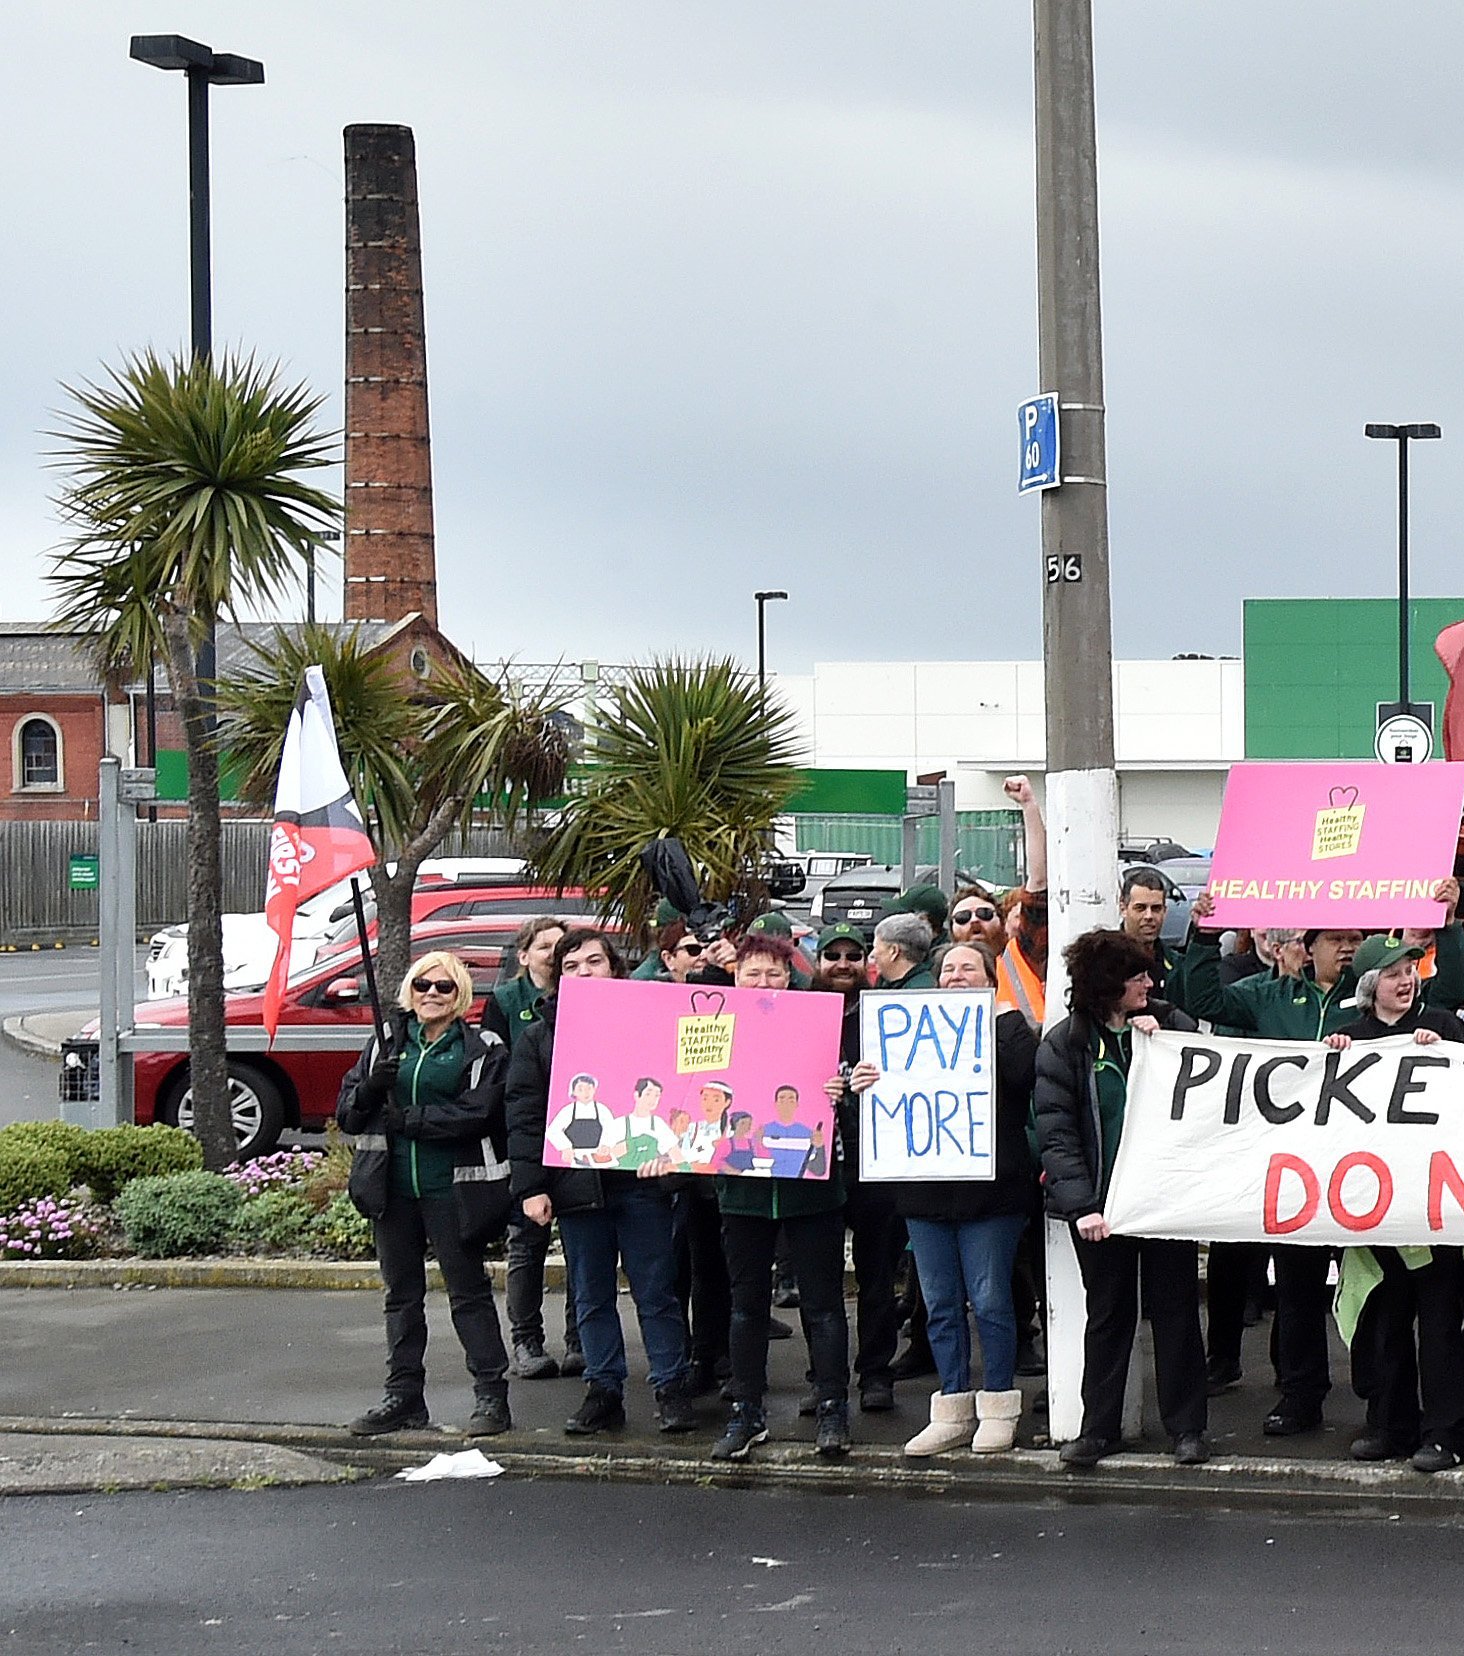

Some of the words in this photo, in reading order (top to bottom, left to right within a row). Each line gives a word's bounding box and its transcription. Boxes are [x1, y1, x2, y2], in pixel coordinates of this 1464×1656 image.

[1025, 405, 1038, 440] P
[1025, 441, 1040, 470] 60
[1210, 879, 1324, 900] HEALTHY
[685, 1024, 727, 1036] Healthy
[878, 1003, 984, 1073] PAY!
[685, 1045, 724, 1056] Healthy
[871, 1090, 990, 1160] MORE
[1263, 1152, 1394, 1235] DO
